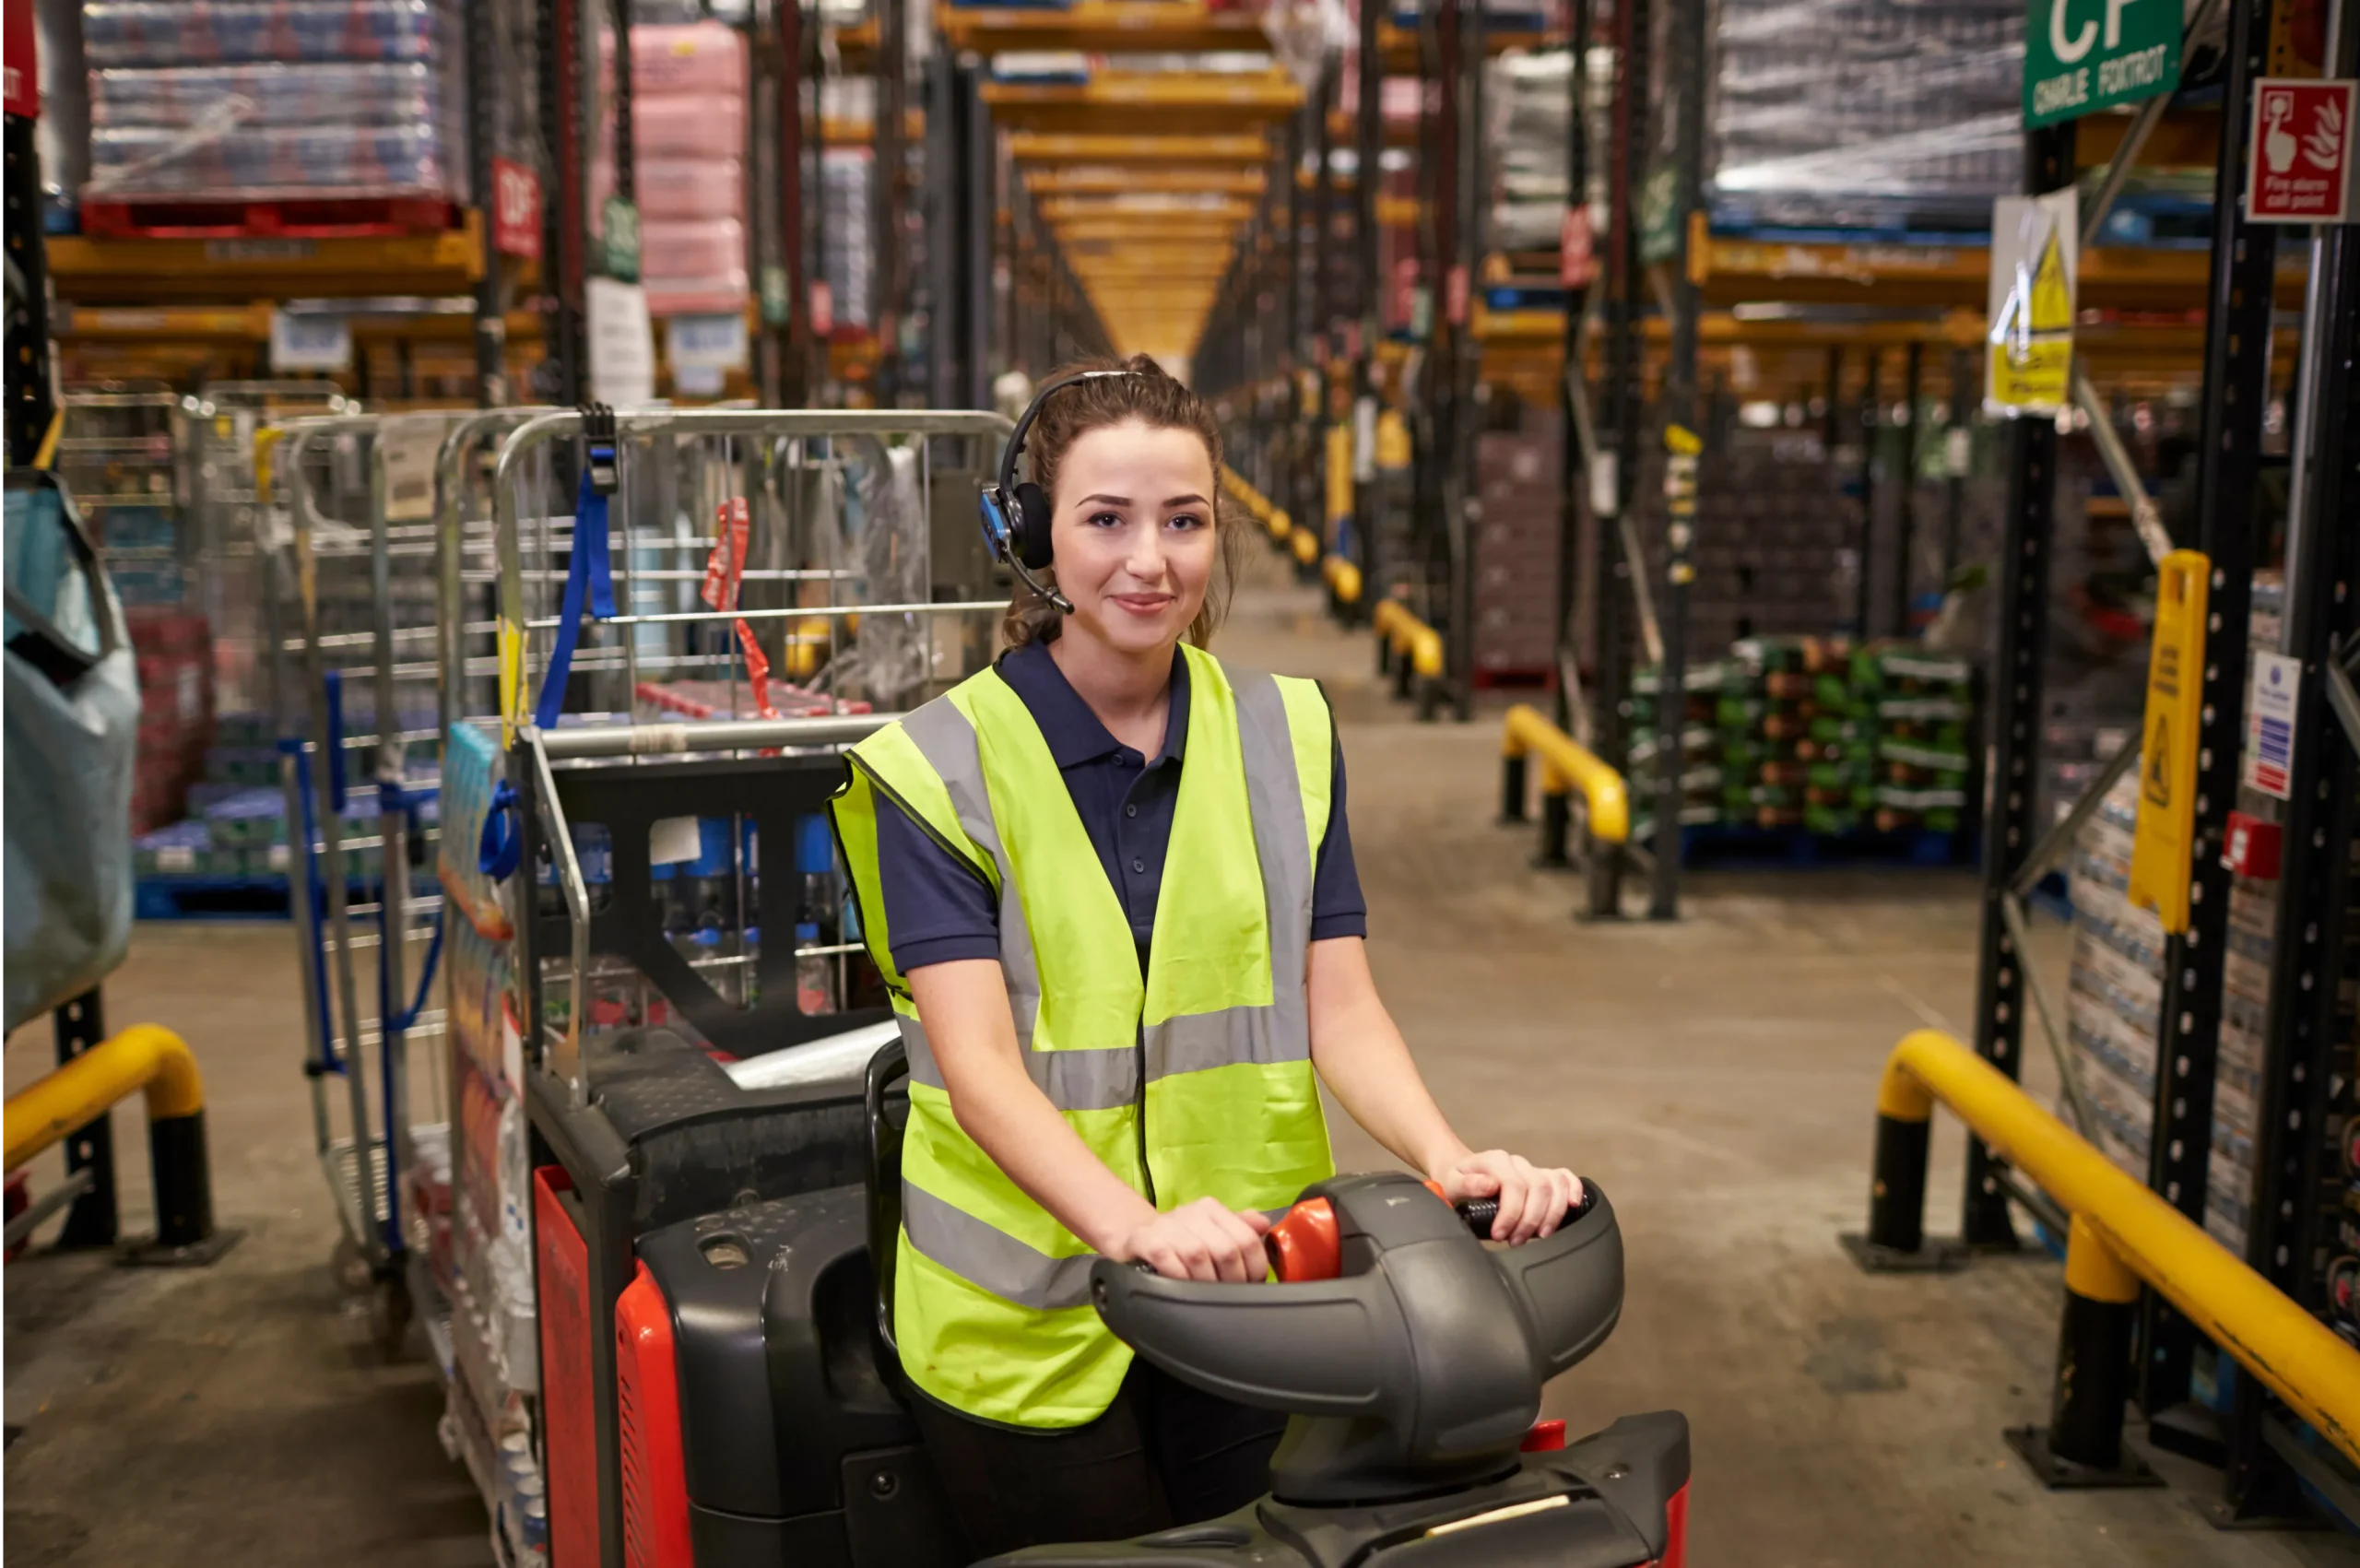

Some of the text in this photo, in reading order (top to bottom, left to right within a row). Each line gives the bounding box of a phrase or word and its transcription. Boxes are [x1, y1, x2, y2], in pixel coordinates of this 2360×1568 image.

[2033, 43, 2166, 116] CHARLIE FOXTROT
[2264, 175, 2329, 192] Fire alarm
[2265, 191, 2326, 210] call point
